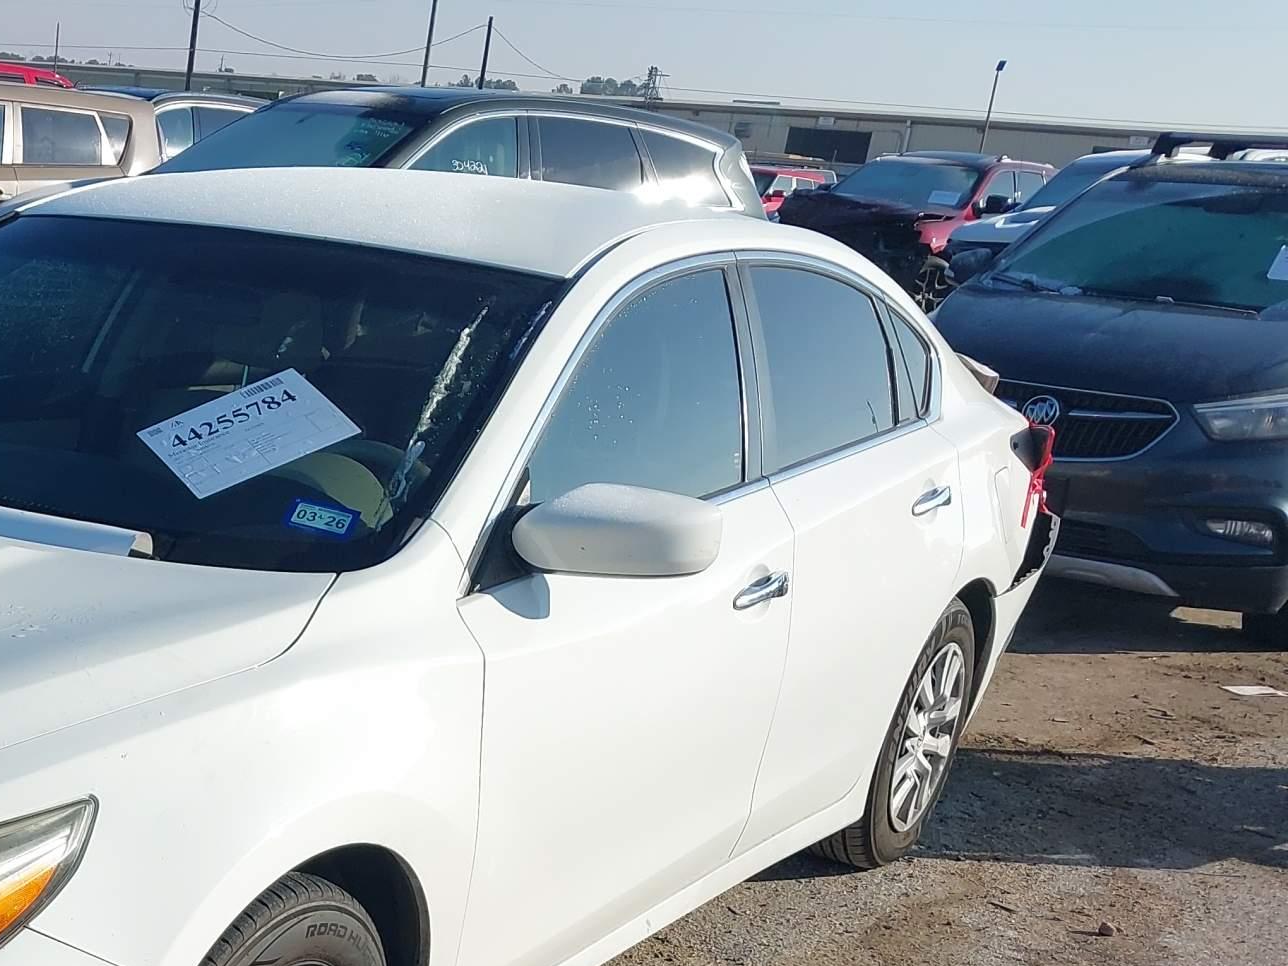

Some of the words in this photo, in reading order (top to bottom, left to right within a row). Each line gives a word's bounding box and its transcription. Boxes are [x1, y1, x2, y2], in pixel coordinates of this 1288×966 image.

[172, 390, 297, 447] 44255784
[296, 508, 318, 523] 03
[324, 515, 347, 530] 26
[305, 922, 348, 939] ROAD
